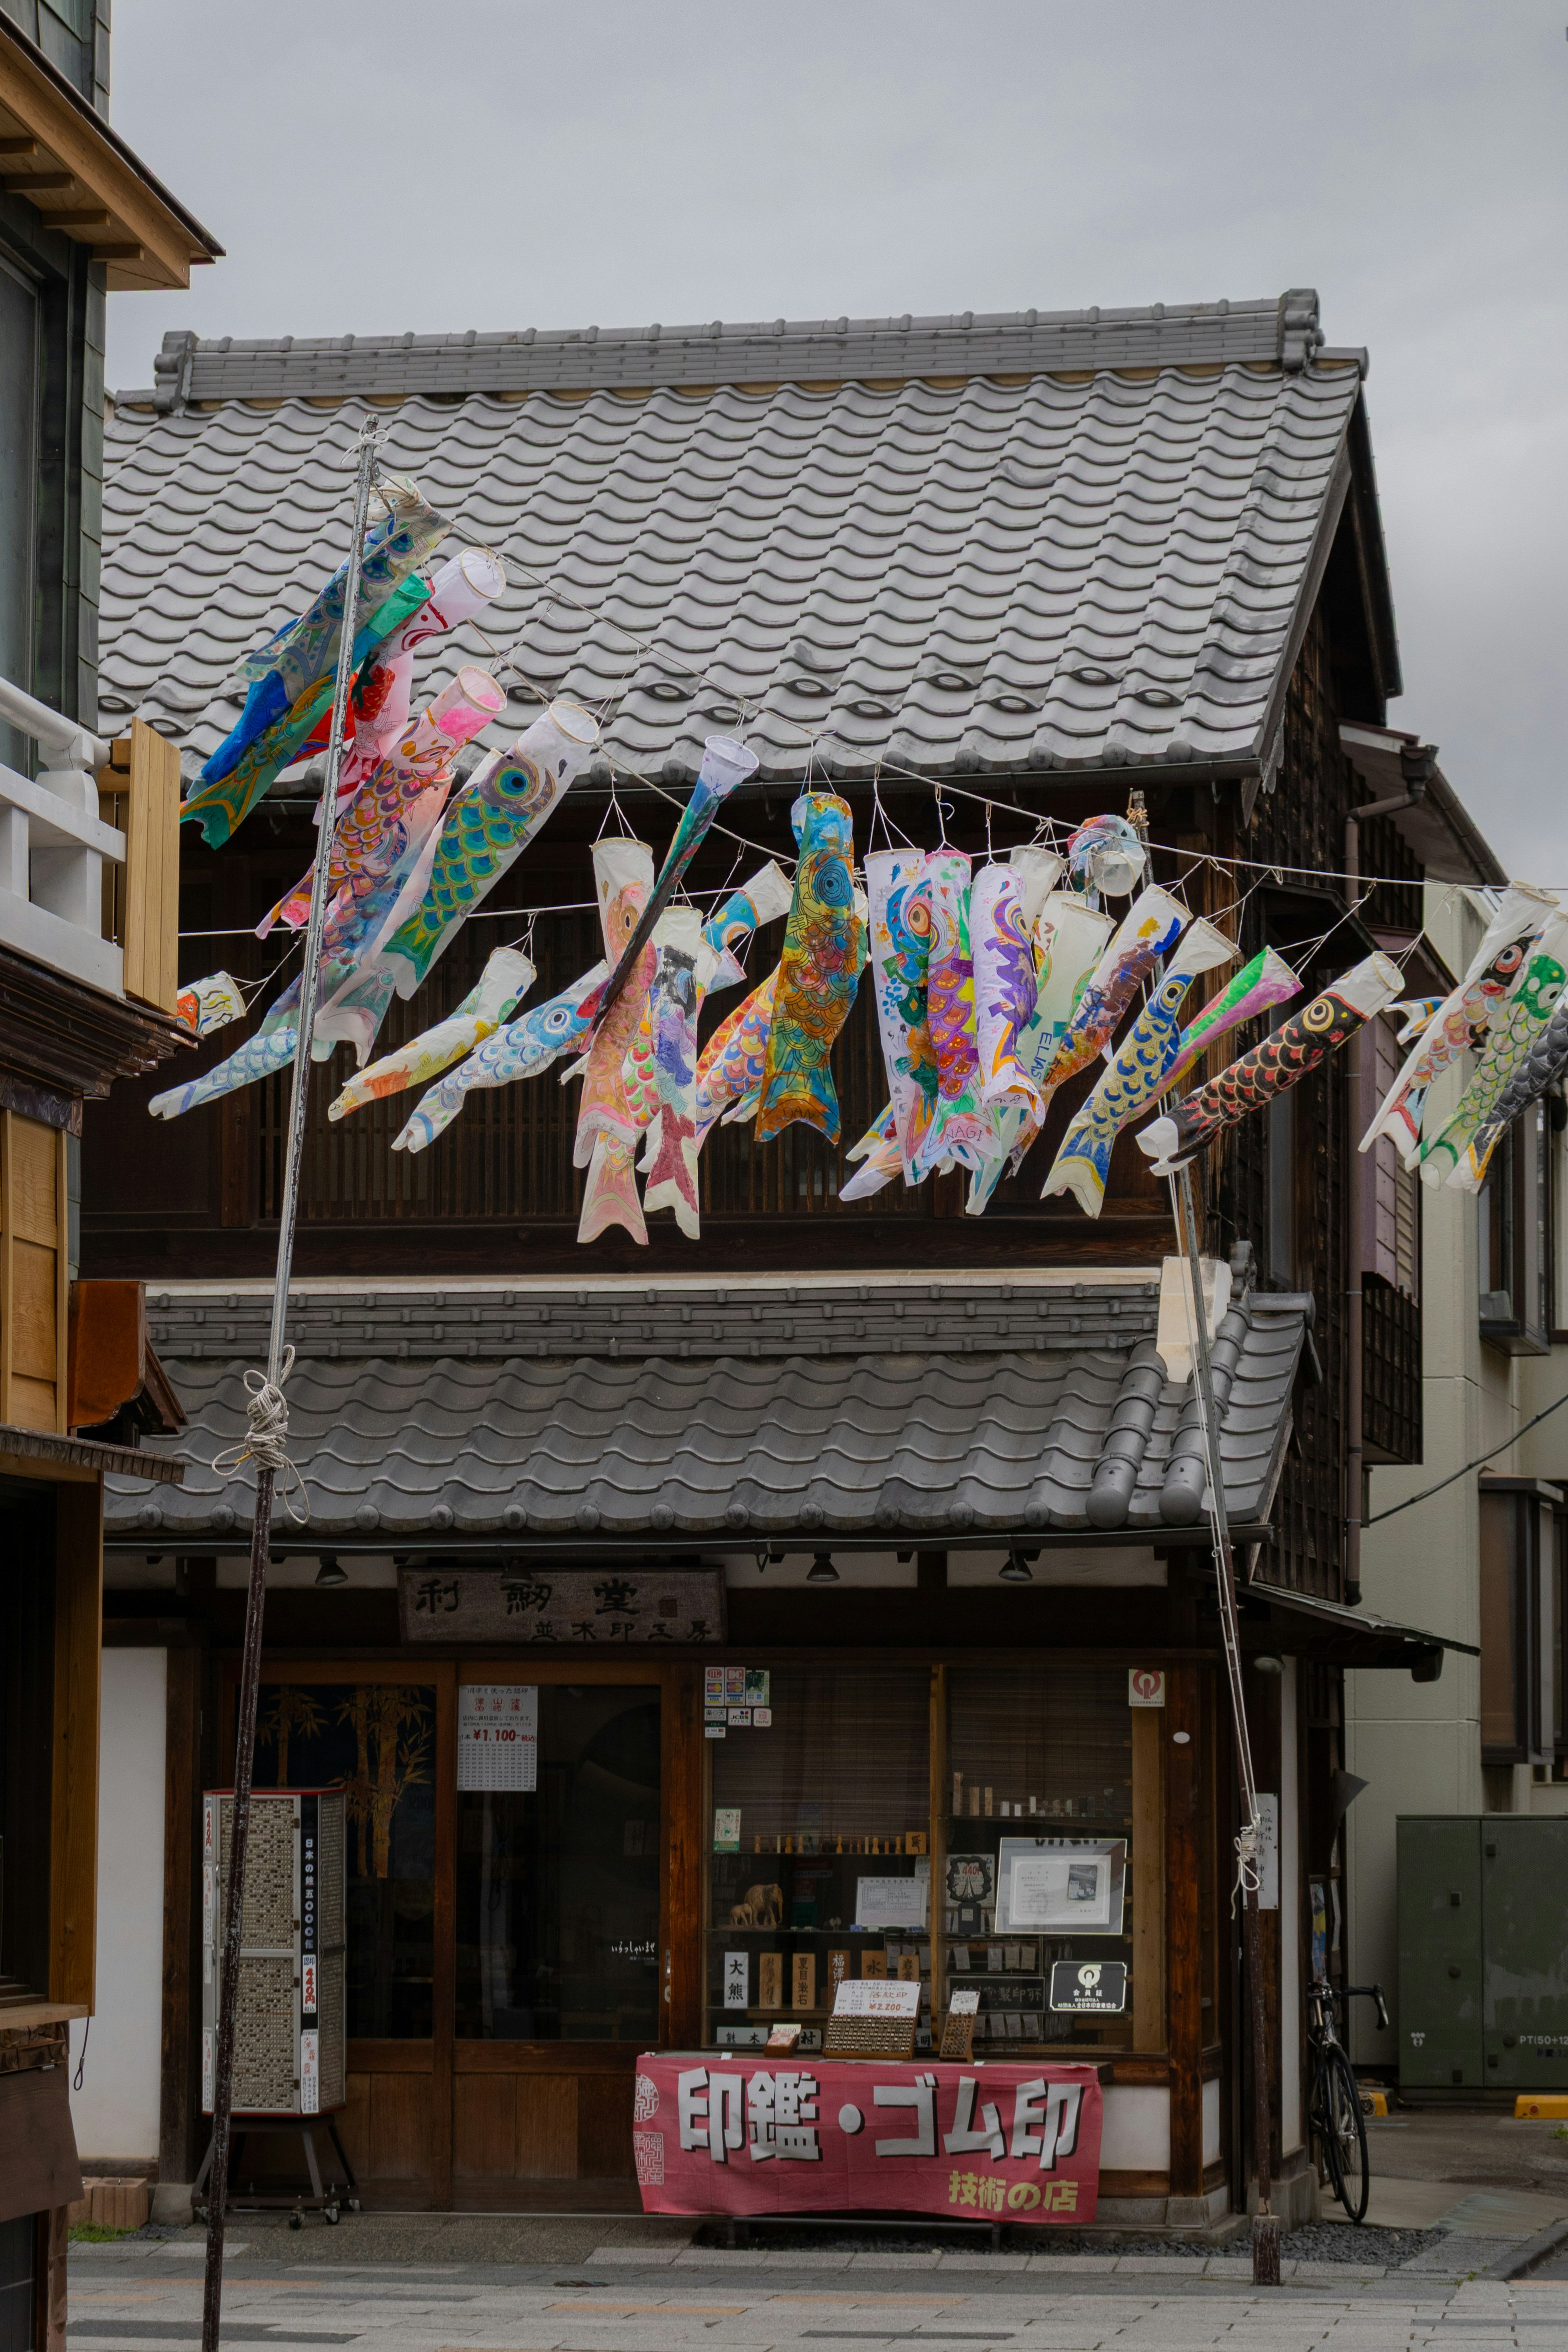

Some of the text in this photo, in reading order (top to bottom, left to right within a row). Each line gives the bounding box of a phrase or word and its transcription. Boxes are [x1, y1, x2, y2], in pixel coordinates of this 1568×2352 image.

[1031, 1032, 1053, 1080] ELIAS
[782, 1106, 815, 1122] DAN
[946, 1126, 982, 1142] NAGI
[612, 1941, 655, 1955] いらっしゃいませ
[305, 1968, 315, 2004] 440円
[728, 1959, 744, 2000] 大熊
[798, 1957, 809, 2005] 夏目漱石
[678, 2066, 1083, 2170] 印鑑・ゴム印
[949, 2170, 1079, 2212] 技術の店
